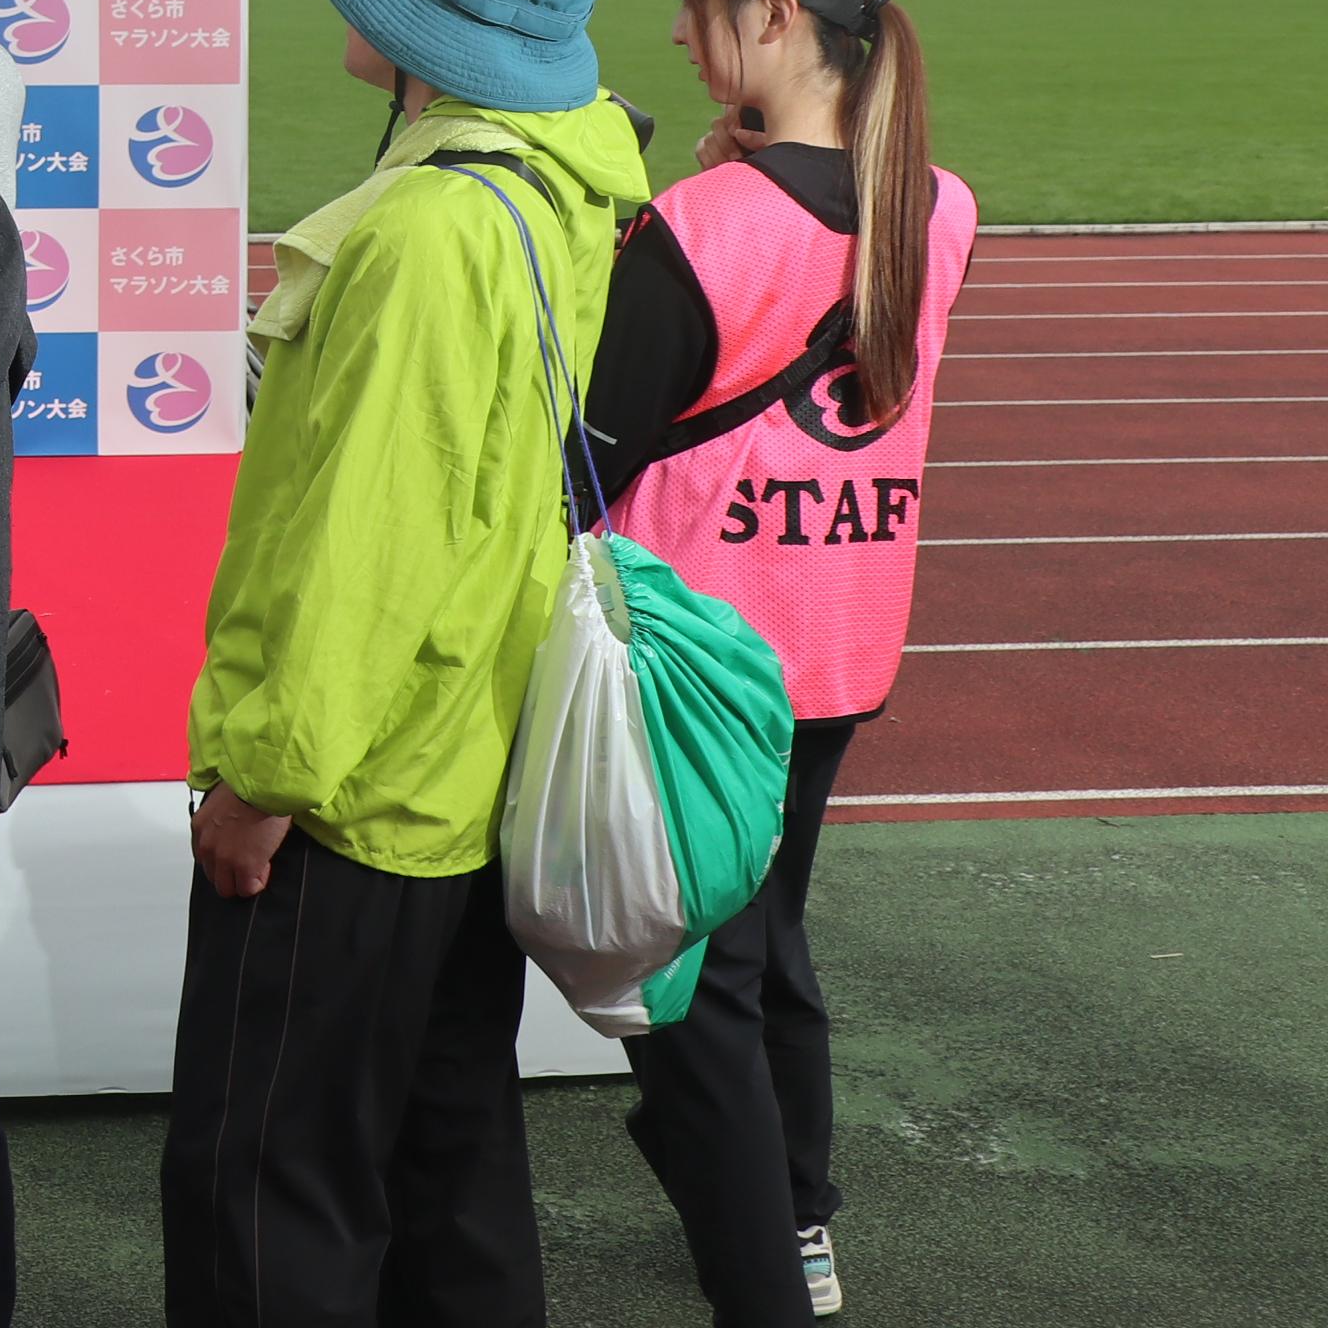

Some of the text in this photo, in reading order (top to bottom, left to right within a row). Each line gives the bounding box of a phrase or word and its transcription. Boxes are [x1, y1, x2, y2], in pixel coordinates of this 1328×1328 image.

[111, 27, 231, 48] マラソン大会
[111, 246, 184, 266] さくら市
[110, 274, 230, 295] マラソン大会
